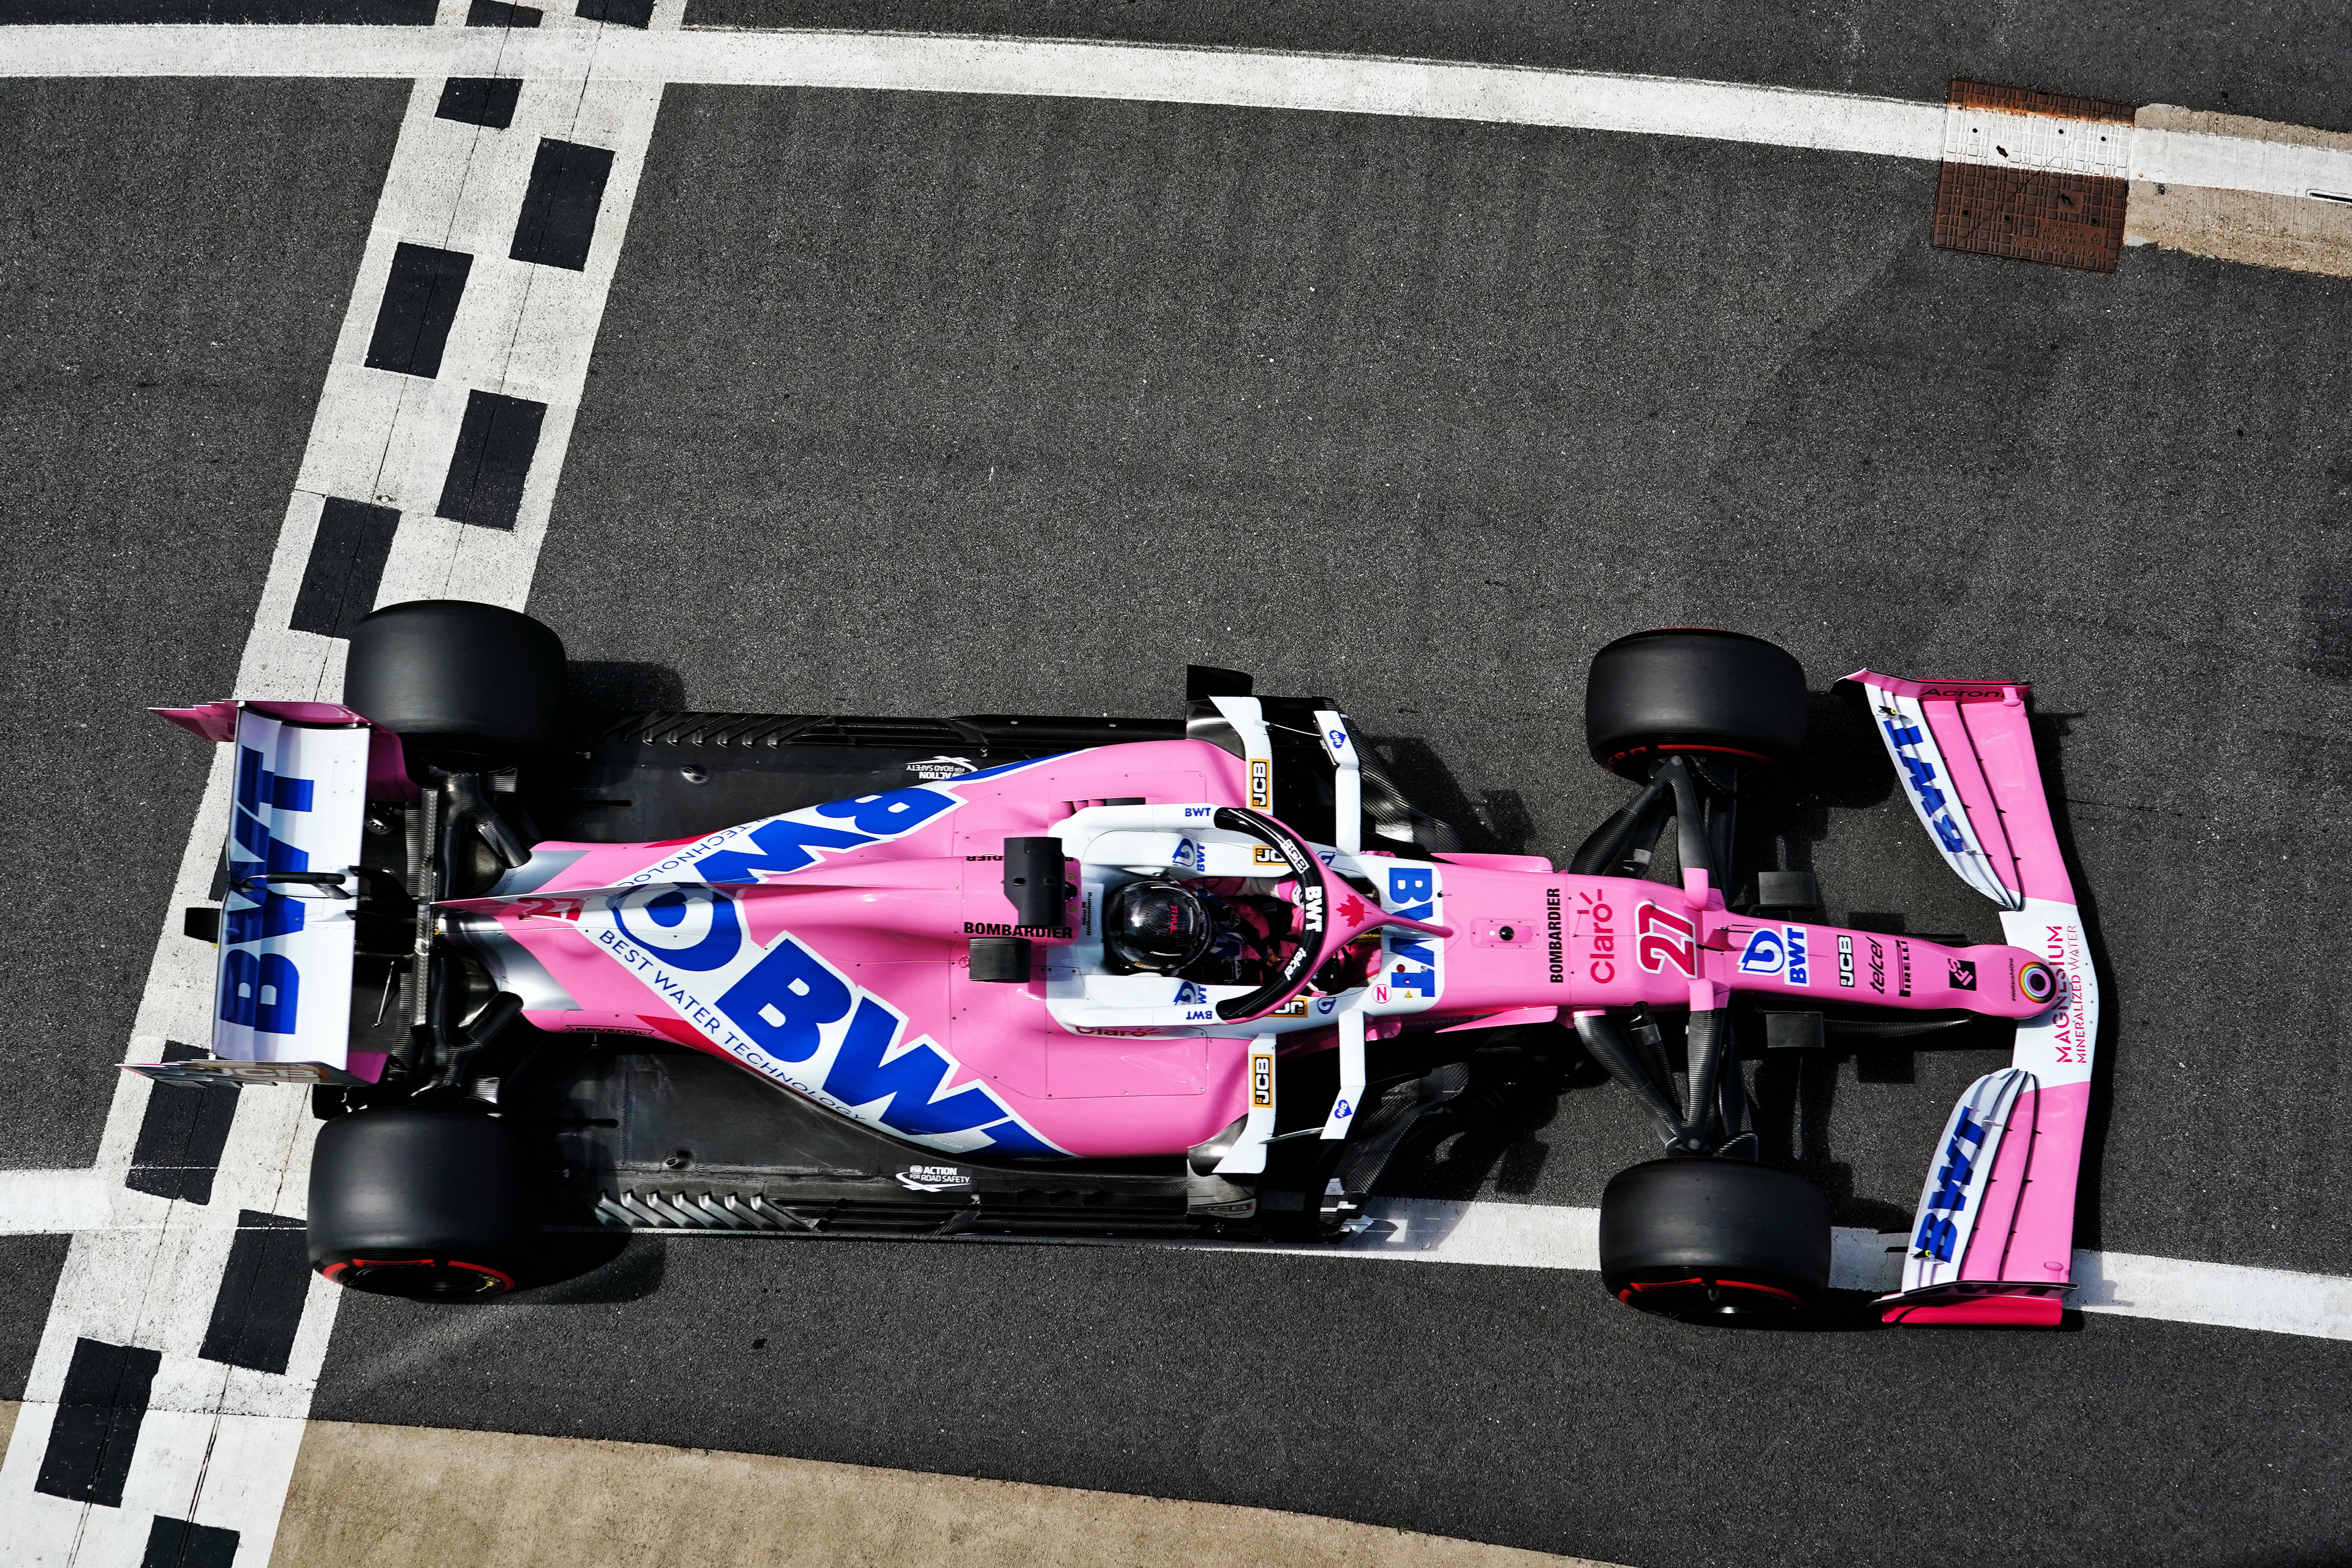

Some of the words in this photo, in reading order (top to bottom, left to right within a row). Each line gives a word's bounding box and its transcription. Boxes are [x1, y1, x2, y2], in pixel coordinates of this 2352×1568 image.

[2047, 220, 2078, 230] DUCTILE
[2013, 238, 2105, 259] MONTGOMERY
[1921, 688, 2021, 698] Acron
[1333, 731, 1343, 746] NHS
[918, 771, 953, 779] ACTION
[1253, 762, 1267, 806] JCB
[1883, 720, 1964, 853] BWT
[1185, 808, 1211, 817] BWT
[617, 825, 751, 887] TECHNOLO
[693, 788, 957, 883] BW
[1197, 843, 1205, 872] BWT
[1256, 852, 1287, 862] JC
[220, 745, 315, 1034] BWT
[517, 897, 585, 922] 27
[1305, 886, 1323, 932] BWT
[964, 922, 1073, 938] BOMBARDIER
[1170, 914, 1178, 934] HUL
[1389, 867, 1436, 997] BWT
[1547, 888, 1564, 983] BOMBARDIER
[1590, 903, 1615, 984] Claro
[1635, 901, 1698, 979] 27
[1284, 947, 1307, 981] telcel
[1787, 927, 1807, 984] BWT
[1838, 936, 1854, 986] JCB
[1866, 936, 1885, 995] telcel
[1895, 940, 1911, 997] PIRELLI
[2067, 925, 2080, 971] WATER
[1948, 958, 1974, 986] IFS
[1186, 1011, 1212, 1020] BWT
[1198, 985, 1207, 1004] WT
[1274, 1001, 1304, 1013] JC
[2046, 926, 2073, 1063] MAGNESIUM
[599, 930, 653, 972] BEST
[654, 970, 720, 1034] WATER
[724, 1032, 867, 1120] TECHNOLOGY
[1075, 1026, 1148, 1037] Claro
[2072, 975, 2087, 1063] MINERALIZED
[714, 938, 1073, 1159] BWT
[1255, 1058, 1270, 1103] JCB
[1337, 1102, 1348, 1117] NHS
[923, 1166, 957, 1175] ACTION
[1915, 1105, 1986, 1263] BWT
